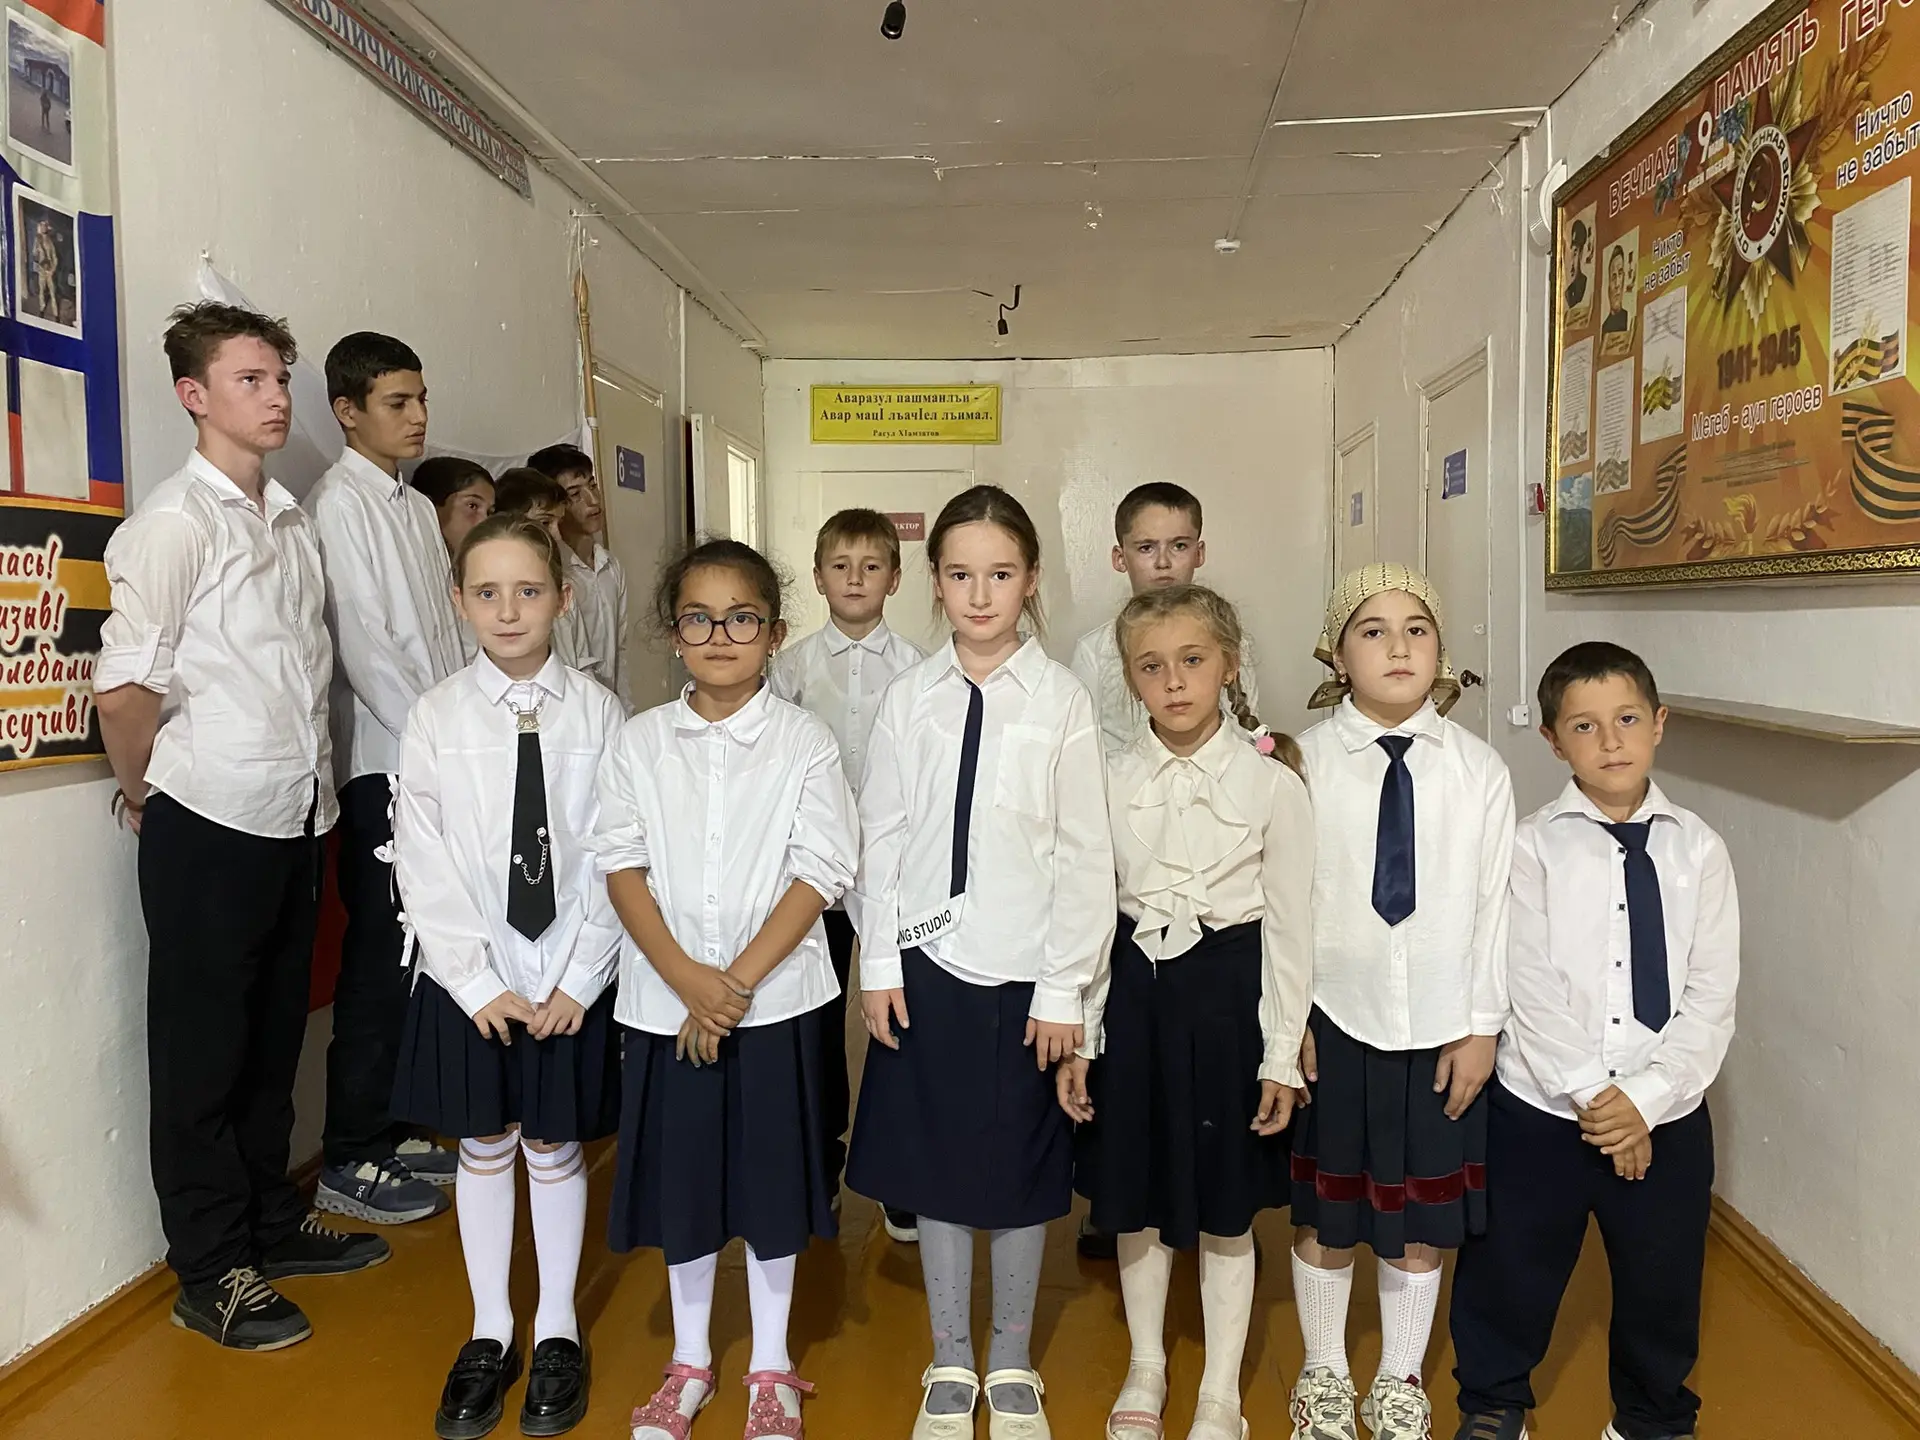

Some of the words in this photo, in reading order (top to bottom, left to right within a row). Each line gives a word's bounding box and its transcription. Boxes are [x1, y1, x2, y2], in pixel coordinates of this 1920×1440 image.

[1609, 134, 1678, 218] ВЕЧНАЯ
[1715, 8, 1820, 120] ПАМЯТЬ
[1839, 0, 1915, 53] ГЕР
[1856, 90, 1913, 145] Ничто
[1698, 111, 1713, 164] 9
[1836, 157, 1858, 190] не
[1862, 120, 1920, 175] забыт
[1652, 229, 1683, 264] Никто
[1643, 271, 1657, 294] не
[1658, 251, 1691, 286] забыт
[821, 409, 851, 423] Авар
[834, 392, 892, 406] Аваразул
[1692, 403, 1730, 441] Мегеб
[1741, 400, 1767, 434] аул
[1769, 384, 1822, 425] героев
[873, 429, 896, 438] Расул
[618, 451, 625, 483] 6
[0, 694, 90, 753] сучив!
[913, 909, 952, 940] STUDIO
